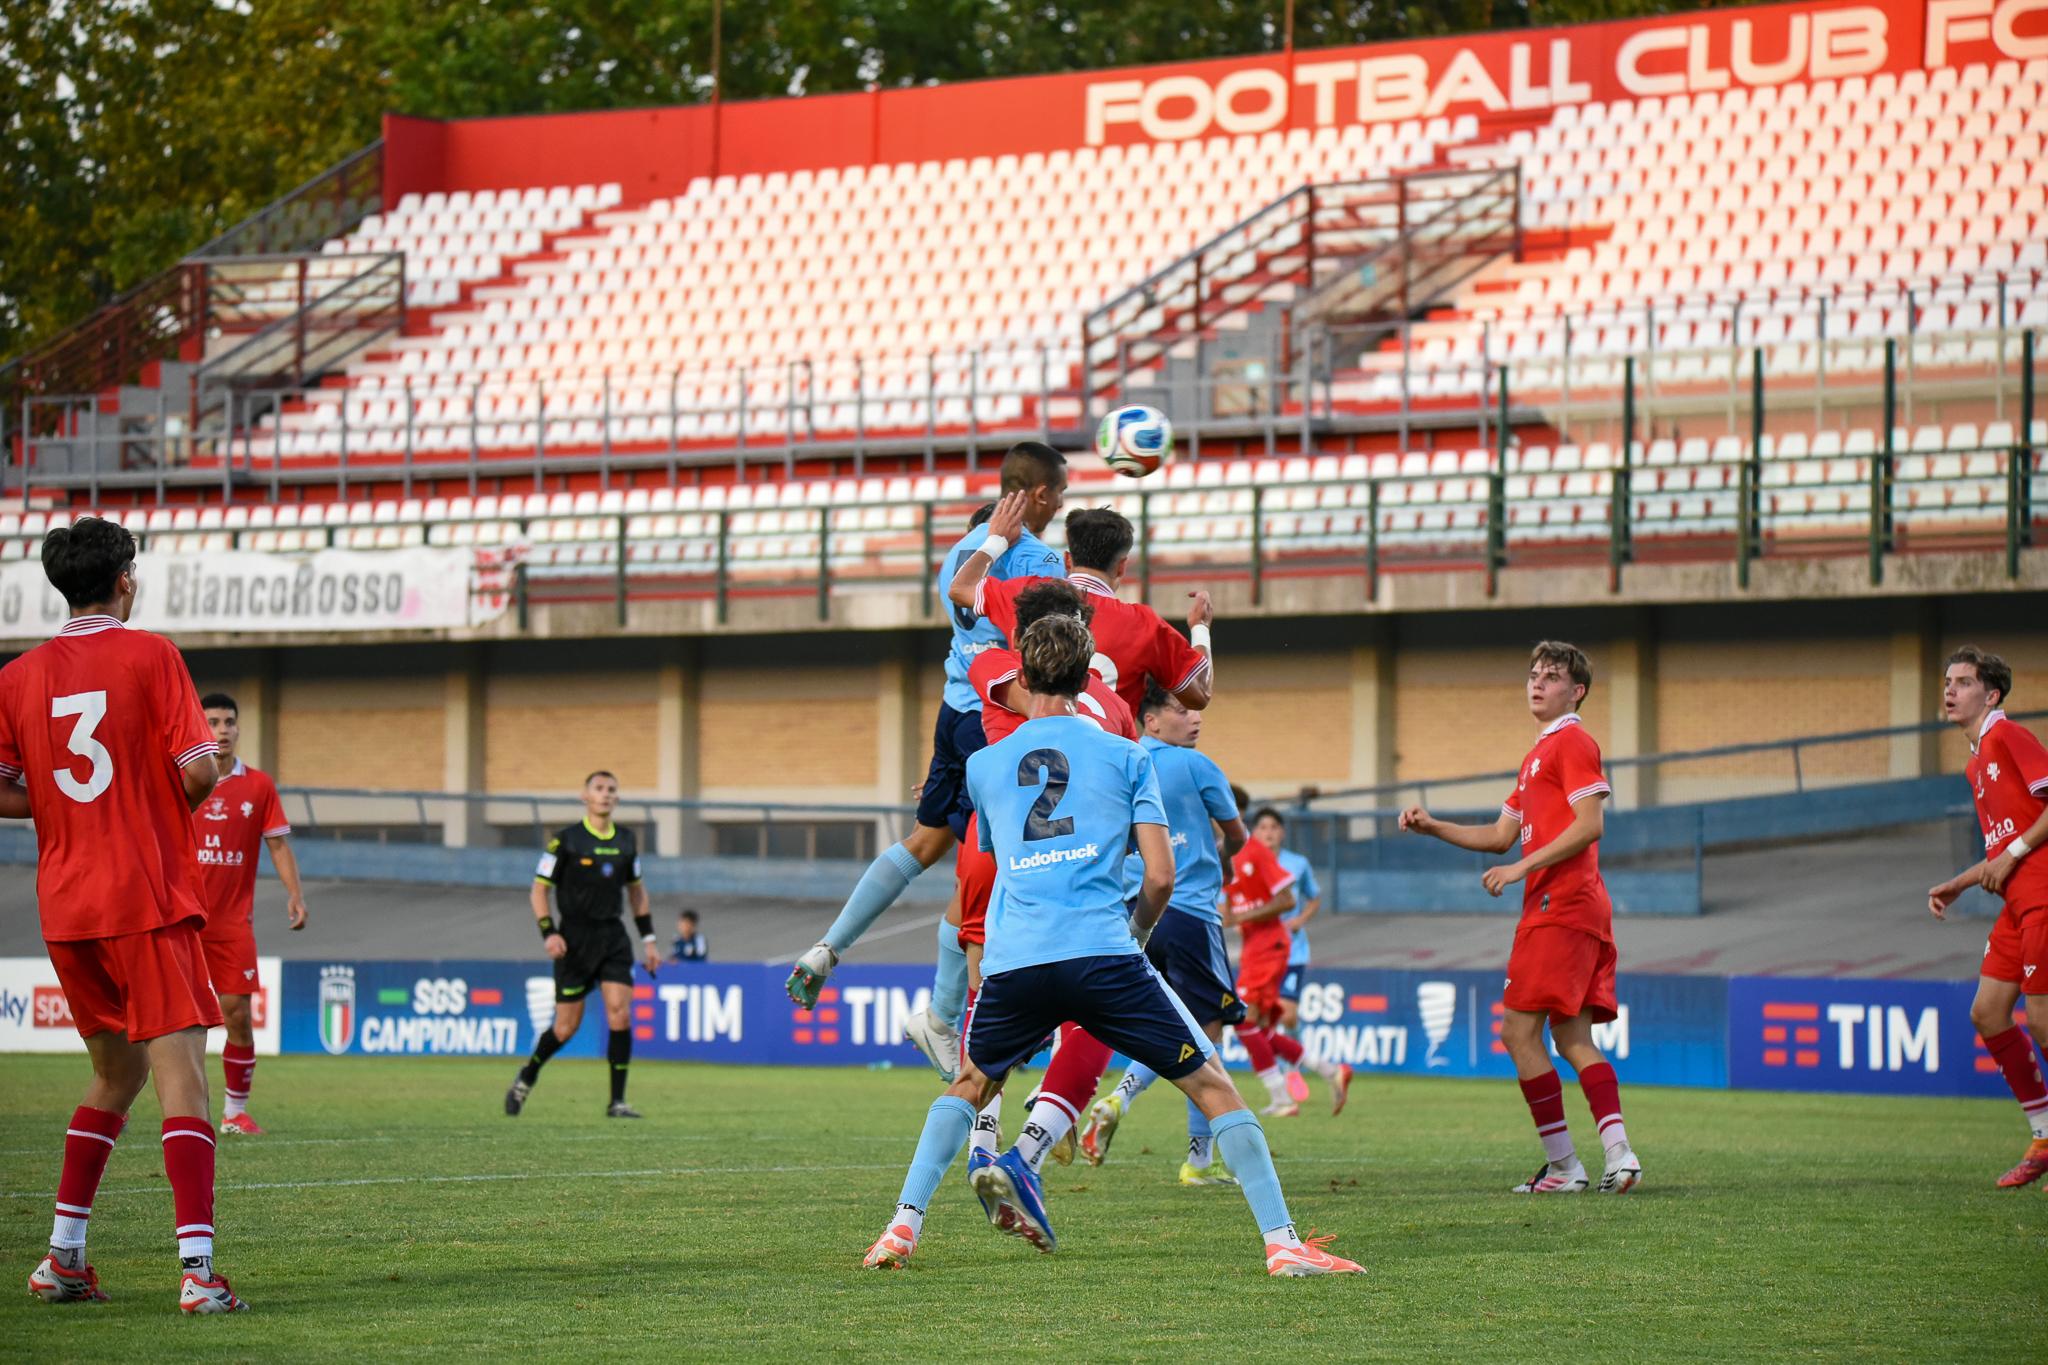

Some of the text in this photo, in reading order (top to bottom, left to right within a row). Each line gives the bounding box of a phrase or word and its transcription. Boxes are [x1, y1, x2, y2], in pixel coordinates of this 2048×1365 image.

[1086, 38, 1591, 146] FOOTBALL
[1616, 7, 1889, 95] CLUB
[51, 690, 114, 803] 3
[1017, 748, 1075, 841] 2
[205, 833, 221, 848] LA
[1009, 843, 1099, 870] Lodotruck
[0, 989, 28, 1027] ky
[413, 978, 468, 1015] SGS
[658, 984, 743, 1042] TIM
[1299, 982, 1345, 1023] GS
[361, 1016, 518, 1054] CAMPIONATI
[1222, 1024, 1407, 1066] CIONATI
[1827, 1003, 1940, 1073] TIM
